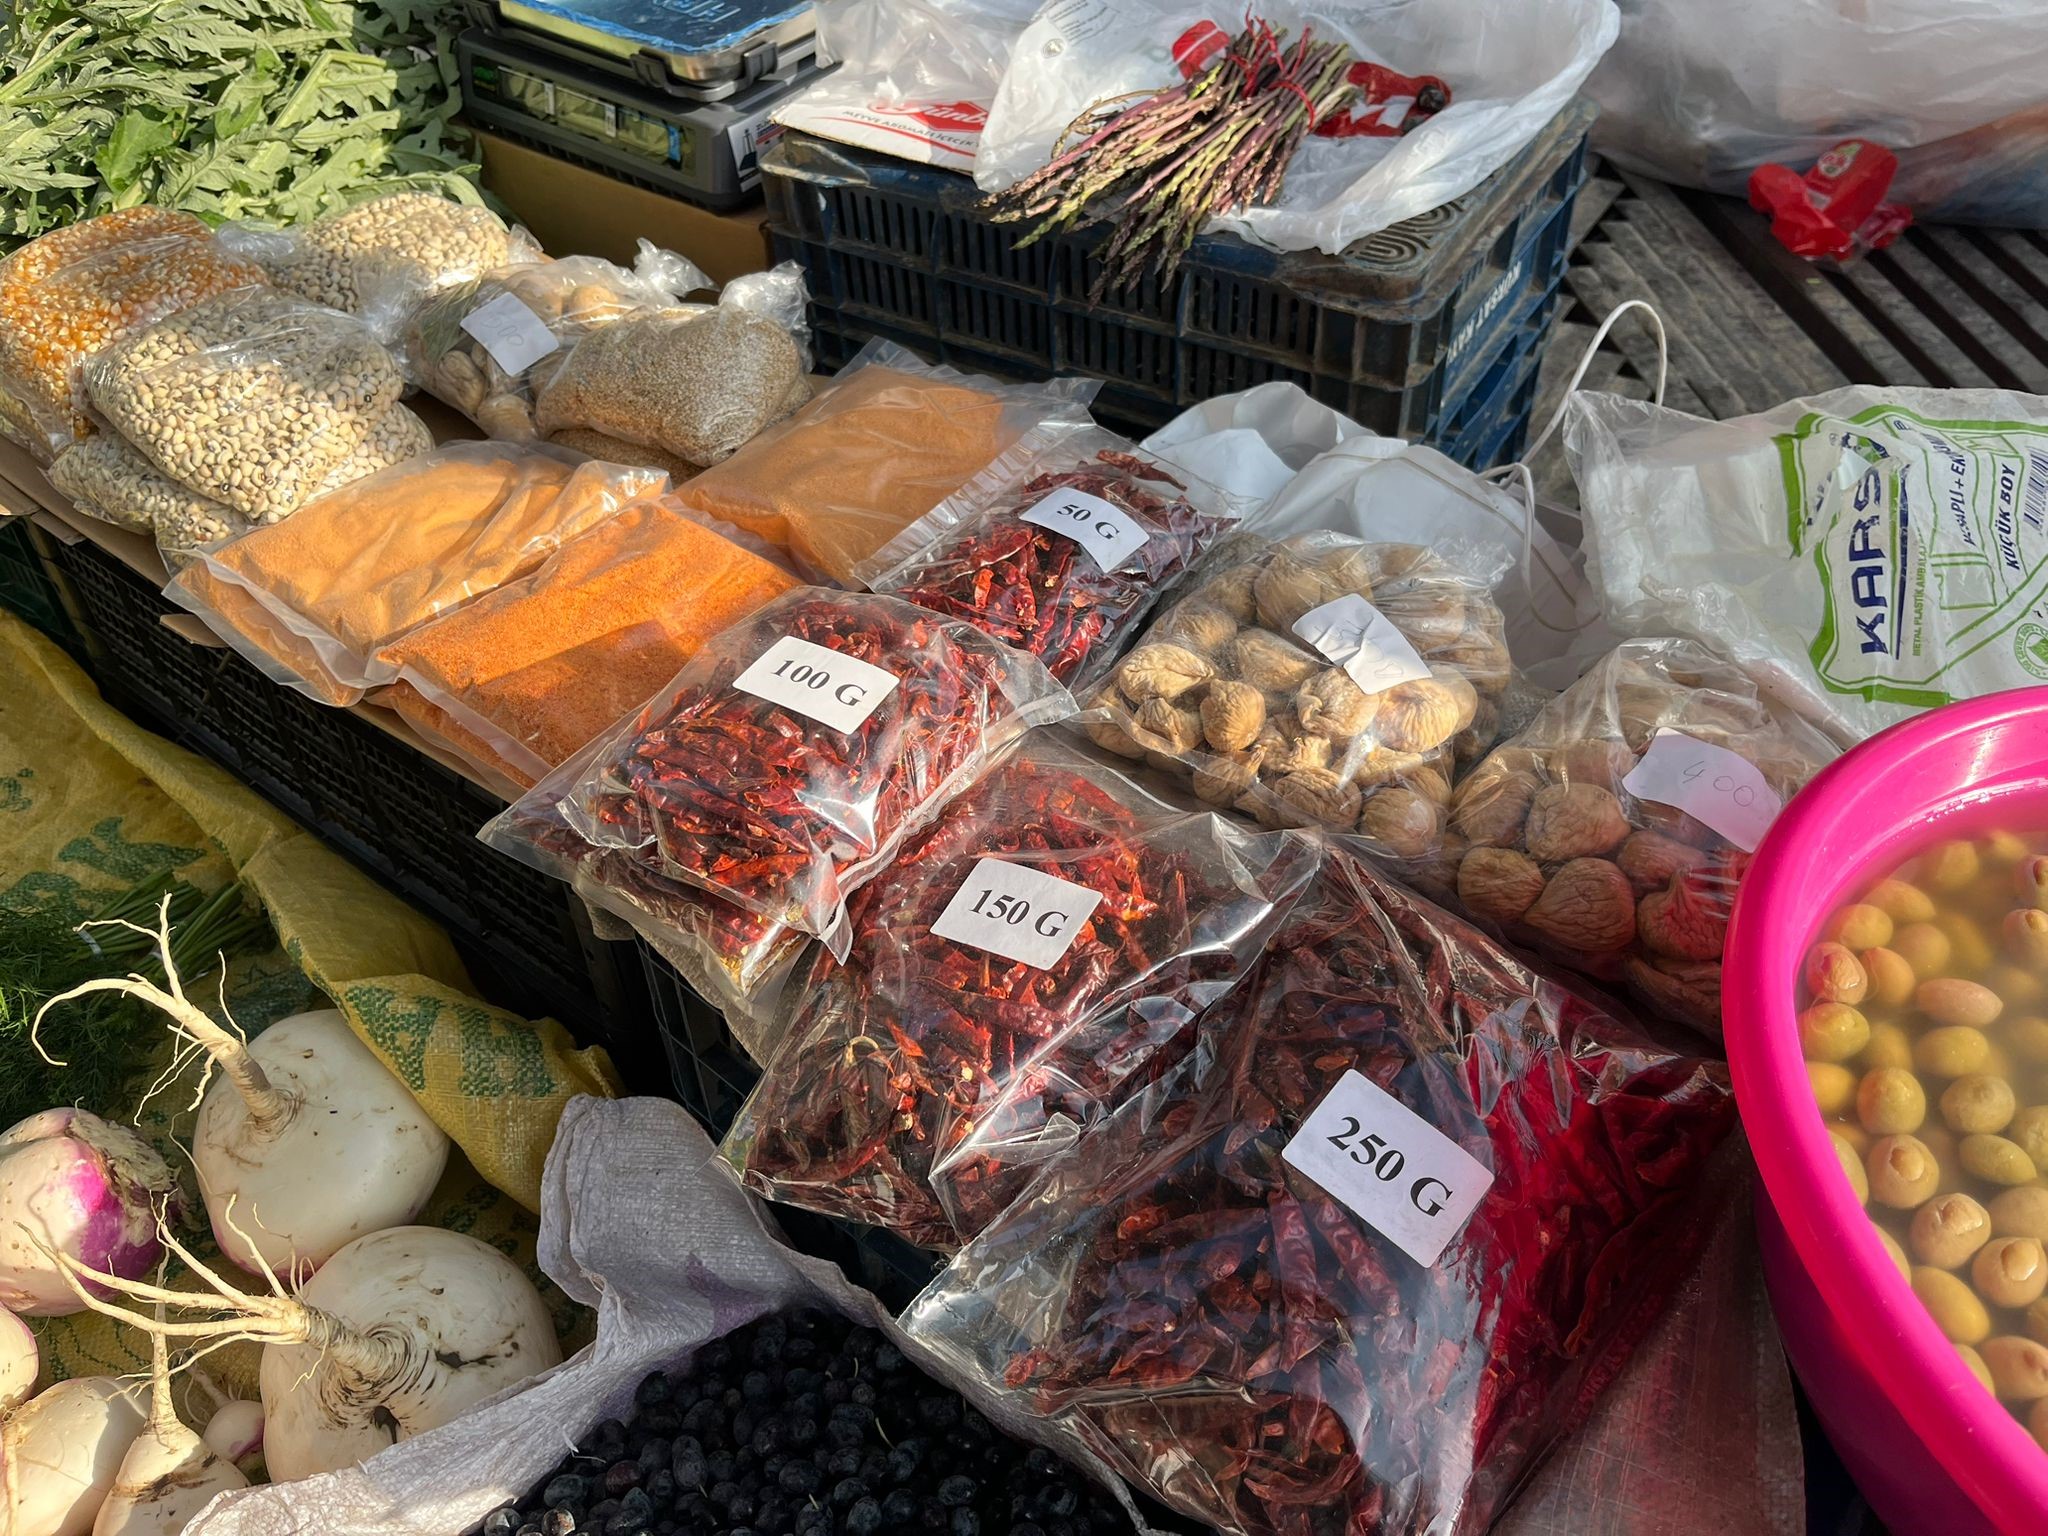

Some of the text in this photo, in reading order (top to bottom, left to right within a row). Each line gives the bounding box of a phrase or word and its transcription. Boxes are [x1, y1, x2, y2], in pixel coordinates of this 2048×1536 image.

[1057, 504, 1120, 540] 50 G
[1995, 463, 2020, 570] KÜÇÜK BOY
[771, 660, 867, 706] 100 G
[969, 889, 1069, 937] 150 G
[1326, 1116, 1453, 1217] 250 G
